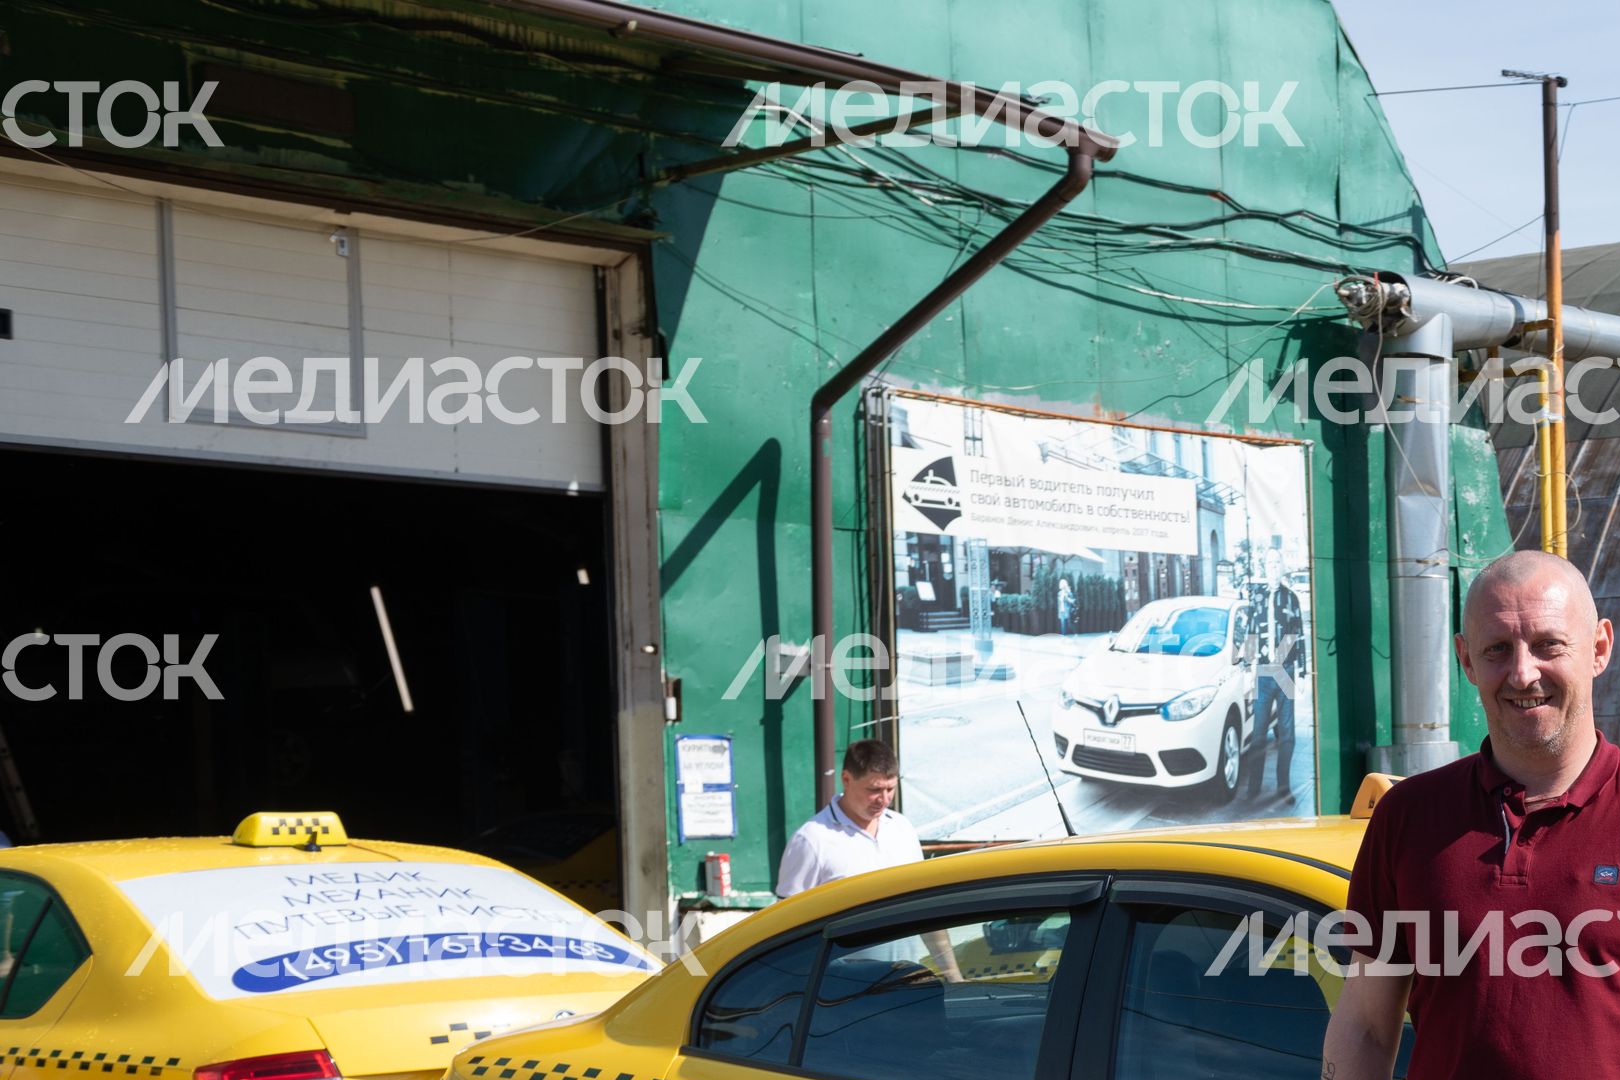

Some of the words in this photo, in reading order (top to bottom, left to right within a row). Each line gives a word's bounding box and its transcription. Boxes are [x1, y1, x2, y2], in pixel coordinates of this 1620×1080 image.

[970, 469, 1025, 487] Первый
[1029, 477, 1092, 496] водитель
[1096, 484, 1154, 501] получил
[970, 491, 1000, 505] свой
[1004, 495, 1083, 514] автомобиль
[1087, 505, 1094, 515] в
[1097, 504, 1190, 524] собственность!
[286, 871, 436, 887] МЕДИК
[282, 887, 488, 907] МЕХАНИК
[234, 903, 428, 940] ПУТЕВЫЕ
[282, 942, 402, 981] (495)
